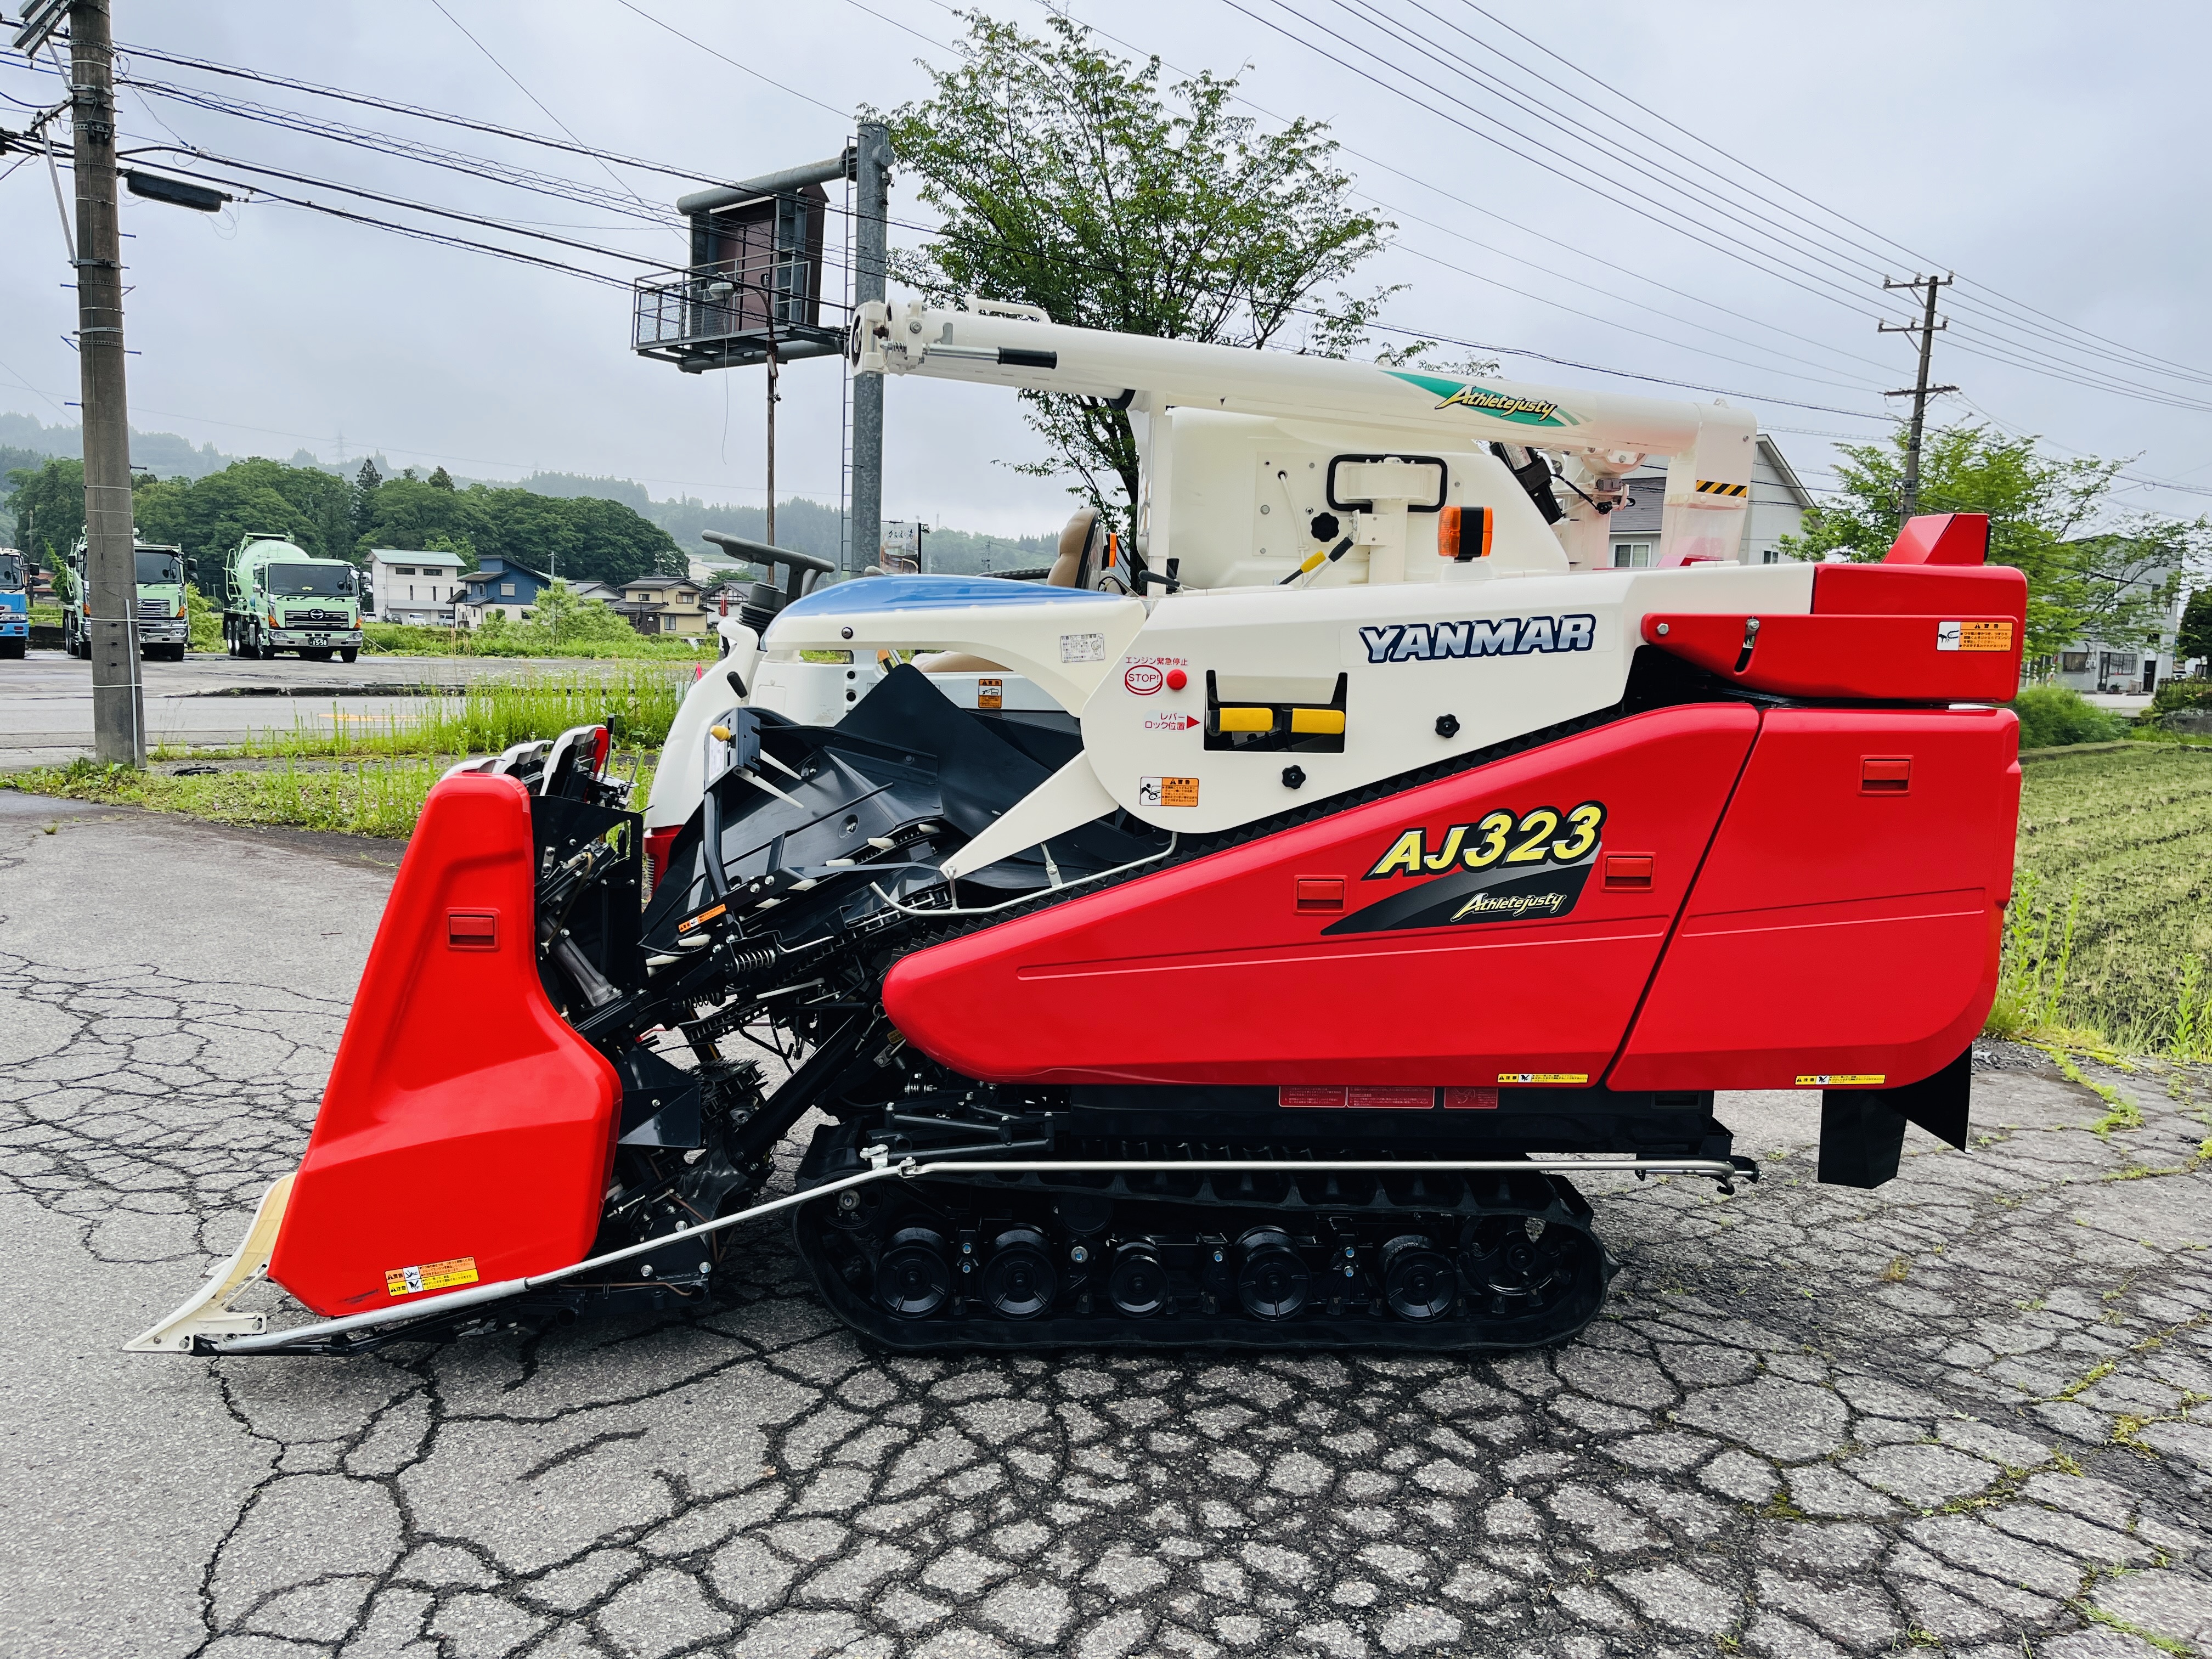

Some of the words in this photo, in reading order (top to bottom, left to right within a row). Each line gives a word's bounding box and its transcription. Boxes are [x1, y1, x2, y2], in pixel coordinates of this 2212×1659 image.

[1435, 385, 1558, 421] Athletejusty
[1359, 613, 1596, 663] YANMAR
[1125, 657, 1188, 666] エンジン緊急停止
[1128, 673, 1159, 683] STOP!
[1160, 712, 1185, 720] レバー
[1145, 721, 1185, 731] ロック位置
[1362, 801, 1607, 881] AJ323
[1450, 893, 1567, 922] Athletejusty
